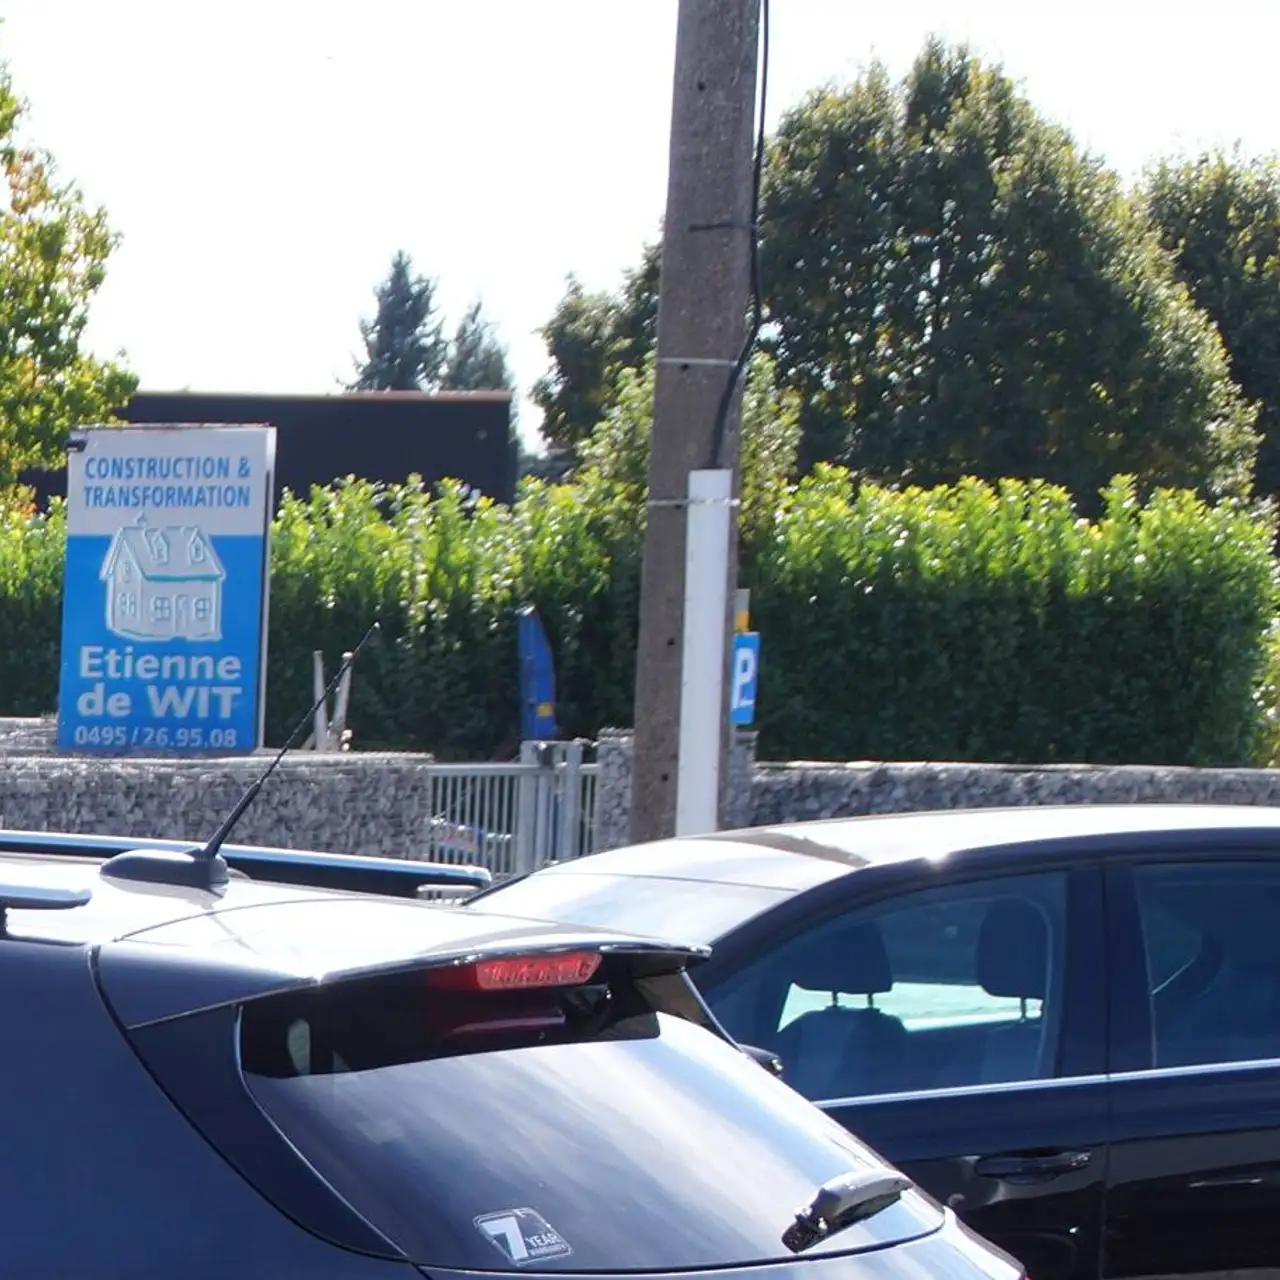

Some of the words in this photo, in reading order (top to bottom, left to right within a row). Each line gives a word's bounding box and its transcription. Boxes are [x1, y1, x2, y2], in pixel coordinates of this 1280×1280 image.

[84, 455, 230, 480] CONSTRUCTION
[237, 456, 251, 479] &
[83, 484, 251, 509] TRANSFORMATION
[80, 645, 242, 680] Etienne
[732, 647, 756, 711] P
[77, 682, 132, 717] de
[147, 685, 242, 719] WIT
[481, 1215, 529, 1261] 7
